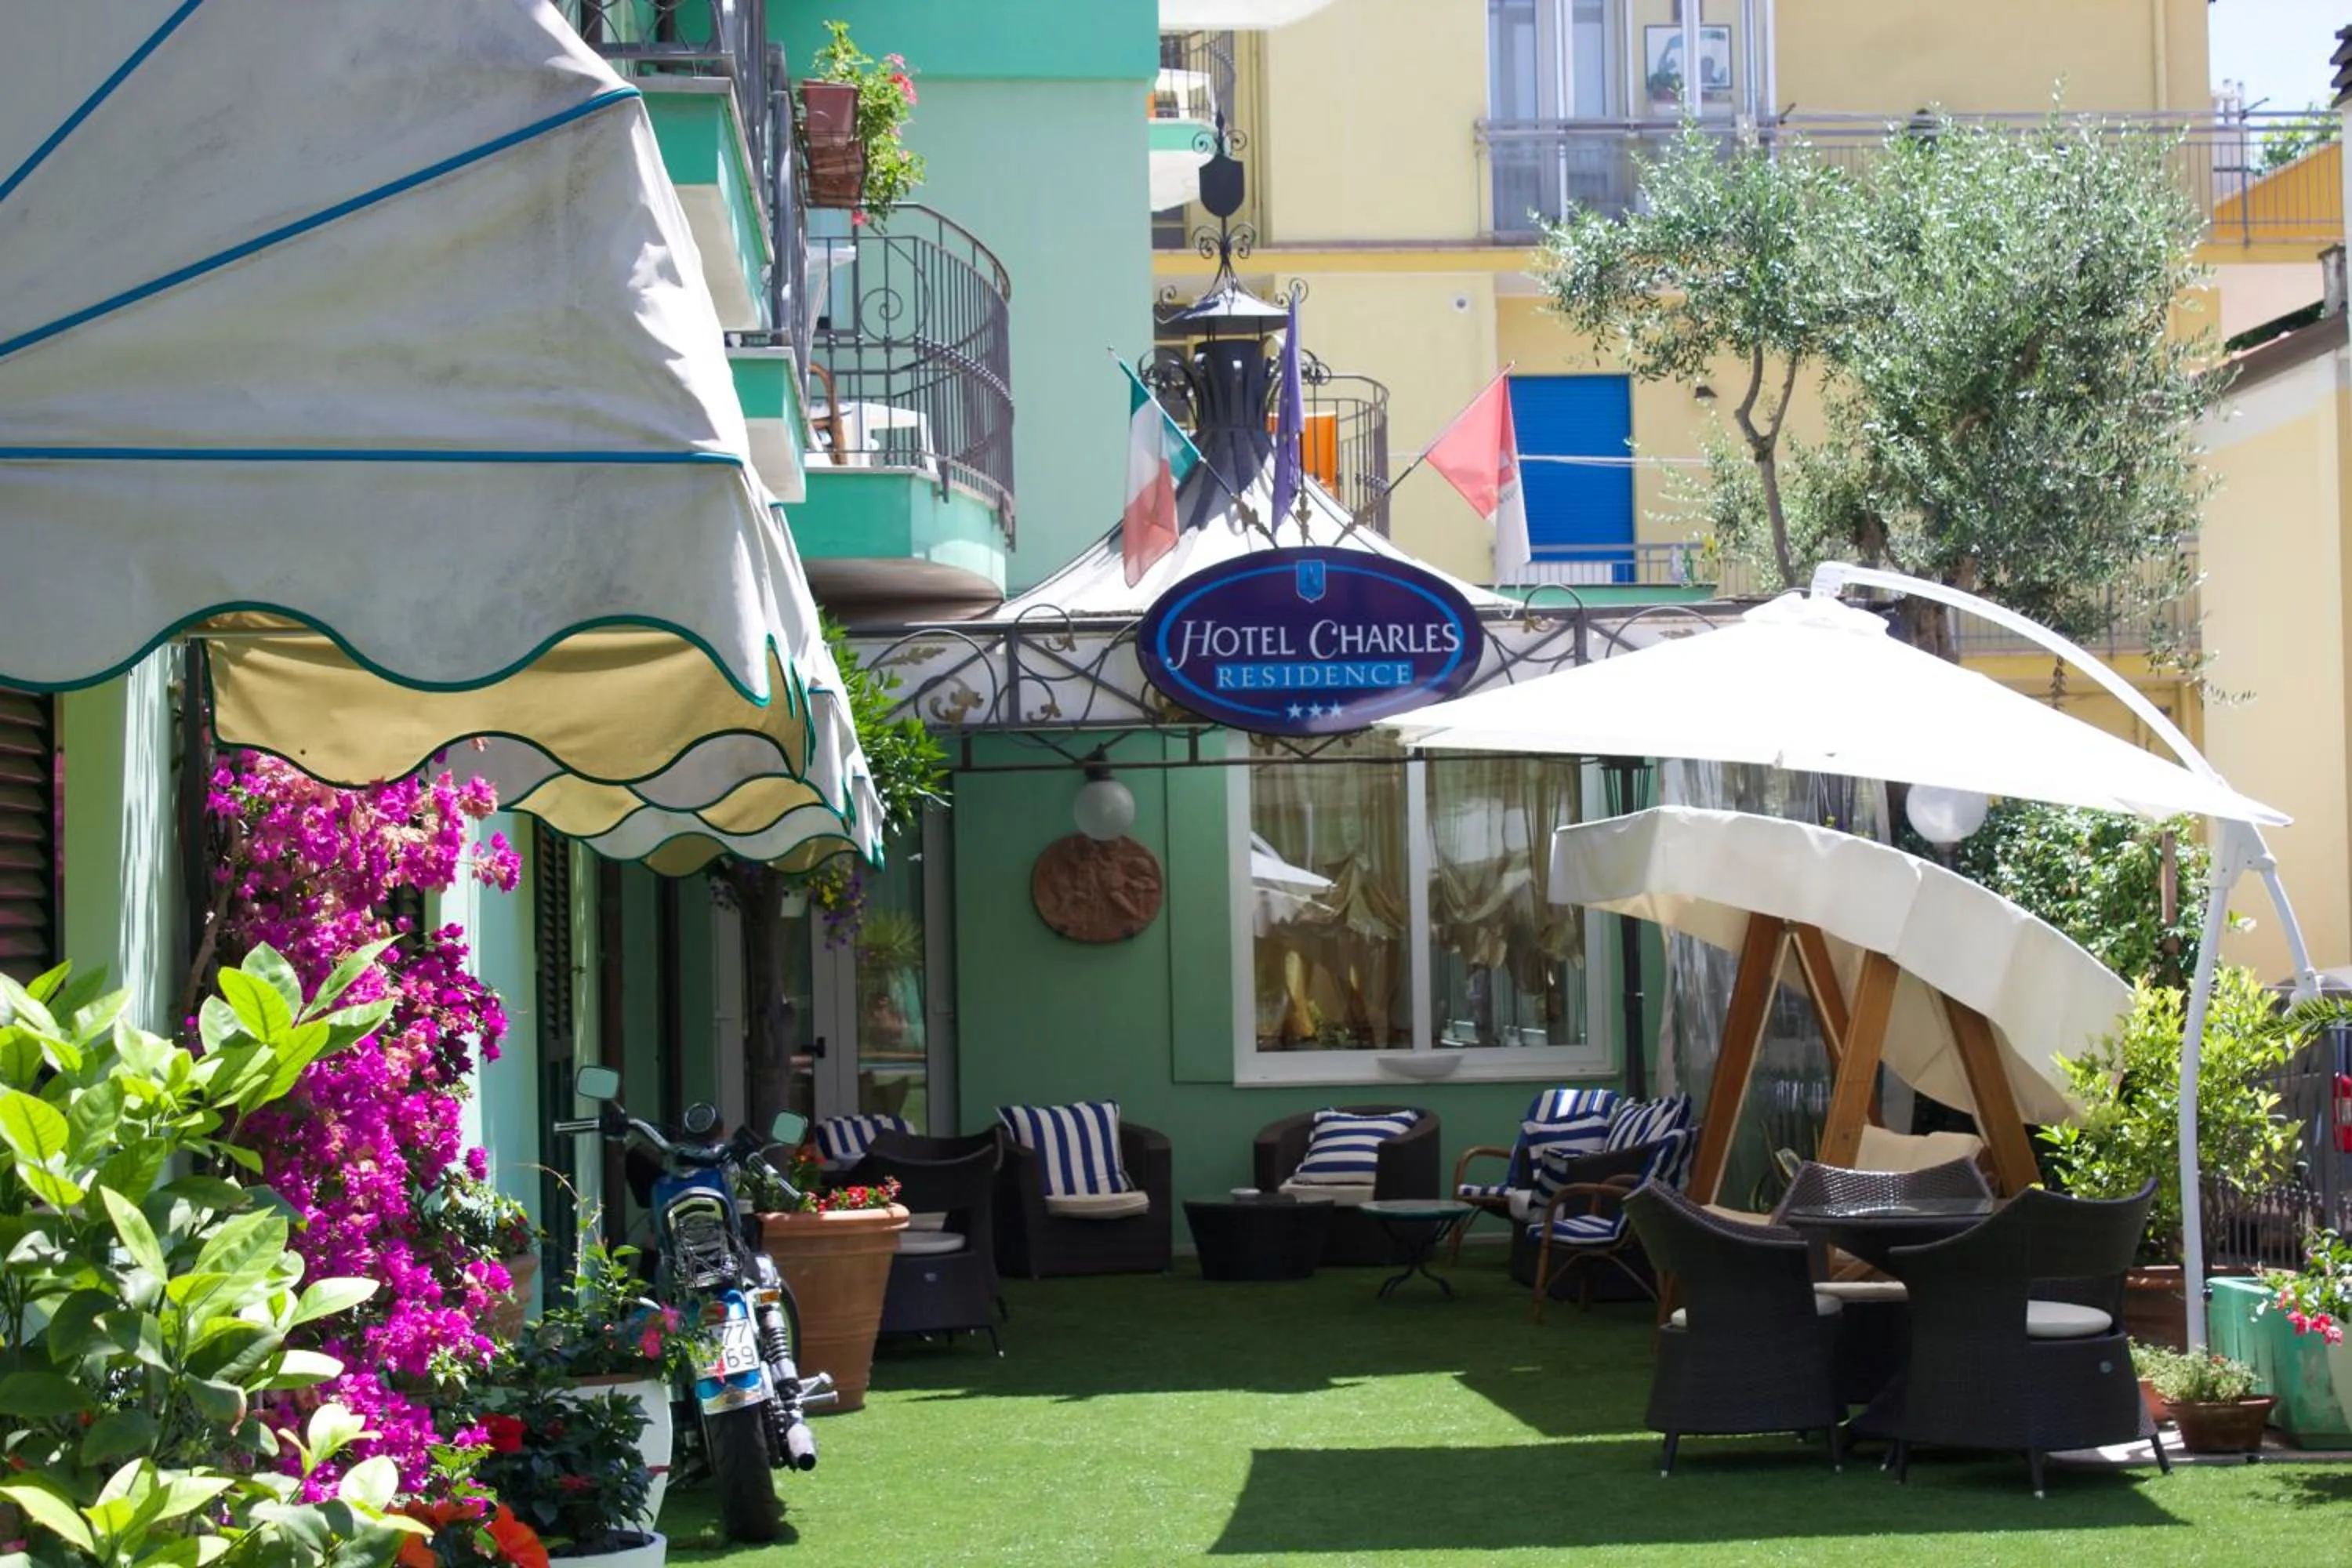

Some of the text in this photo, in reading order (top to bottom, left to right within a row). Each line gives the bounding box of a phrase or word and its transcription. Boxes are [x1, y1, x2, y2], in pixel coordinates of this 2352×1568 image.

[1167, 619, 1461, 671] HOTEL CHARLES
[1216, 663, 1412, 688] RESIDENCE
